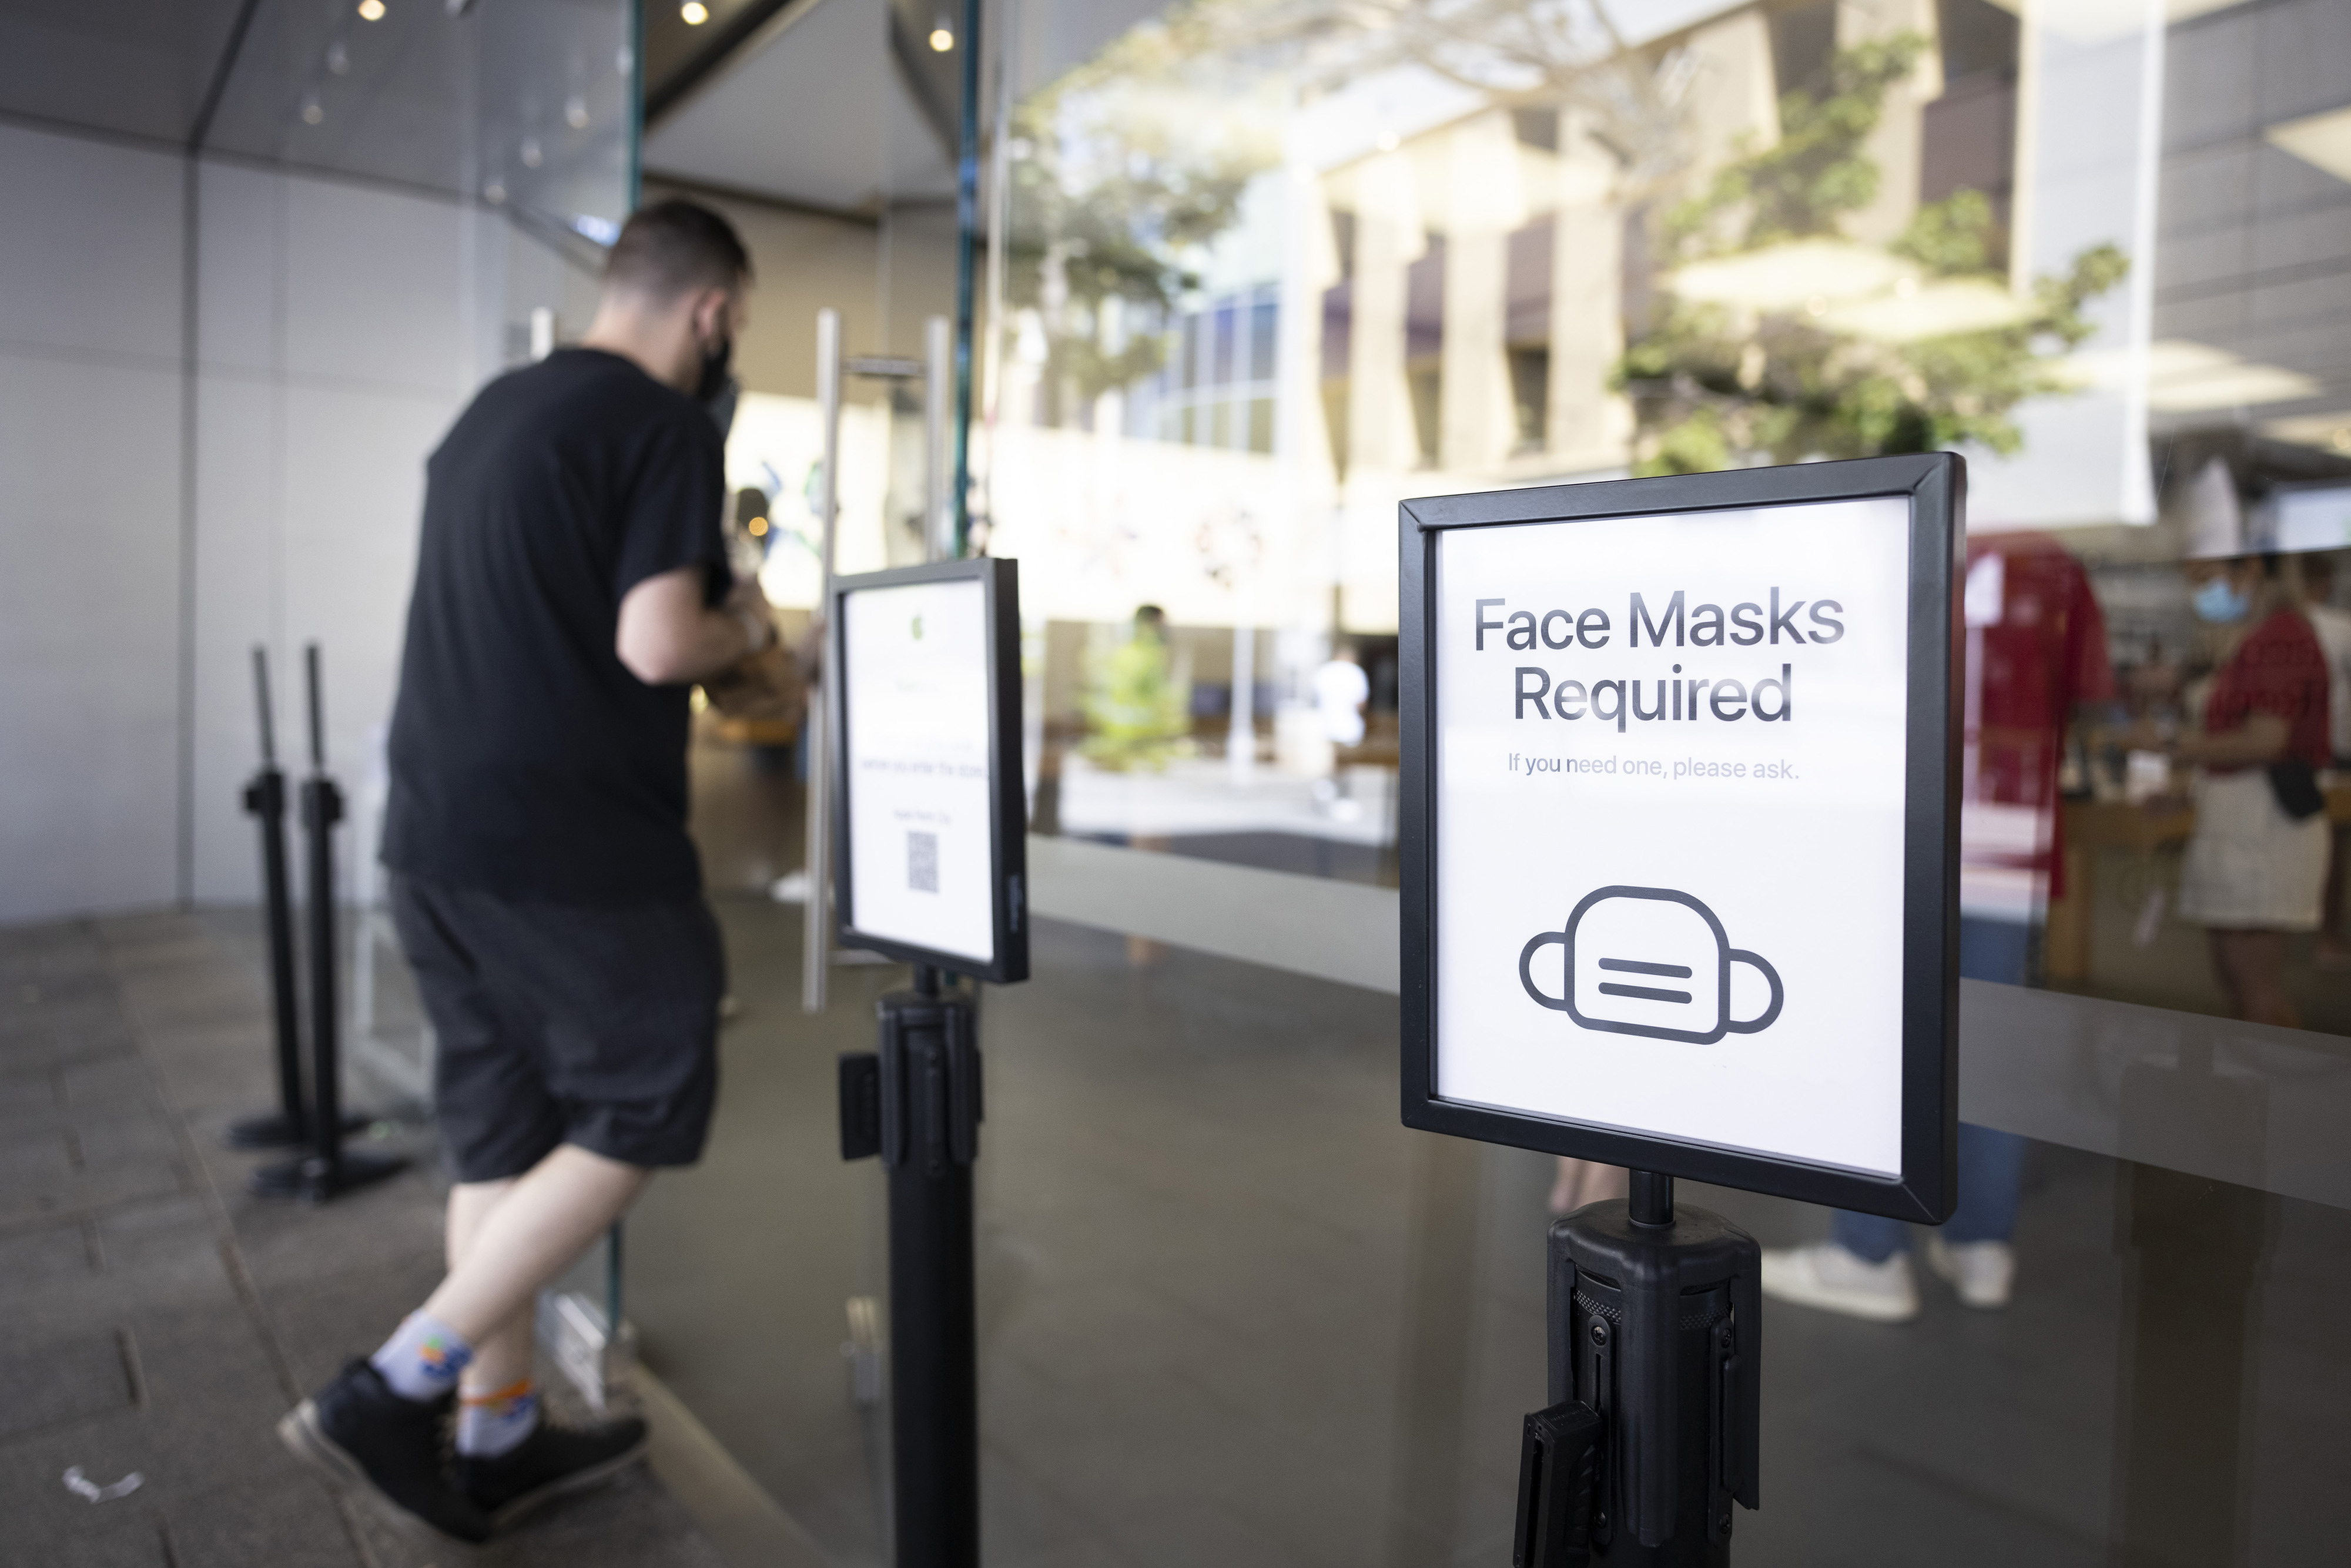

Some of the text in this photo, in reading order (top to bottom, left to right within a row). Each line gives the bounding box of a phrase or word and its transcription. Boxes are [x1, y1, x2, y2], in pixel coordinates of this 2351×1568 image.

[1475, 586, 1845, 652] Face Masks
[1515, 662, 1792, 733] Required
[1509, 752, 1799, 780] If you need one, please ask.
